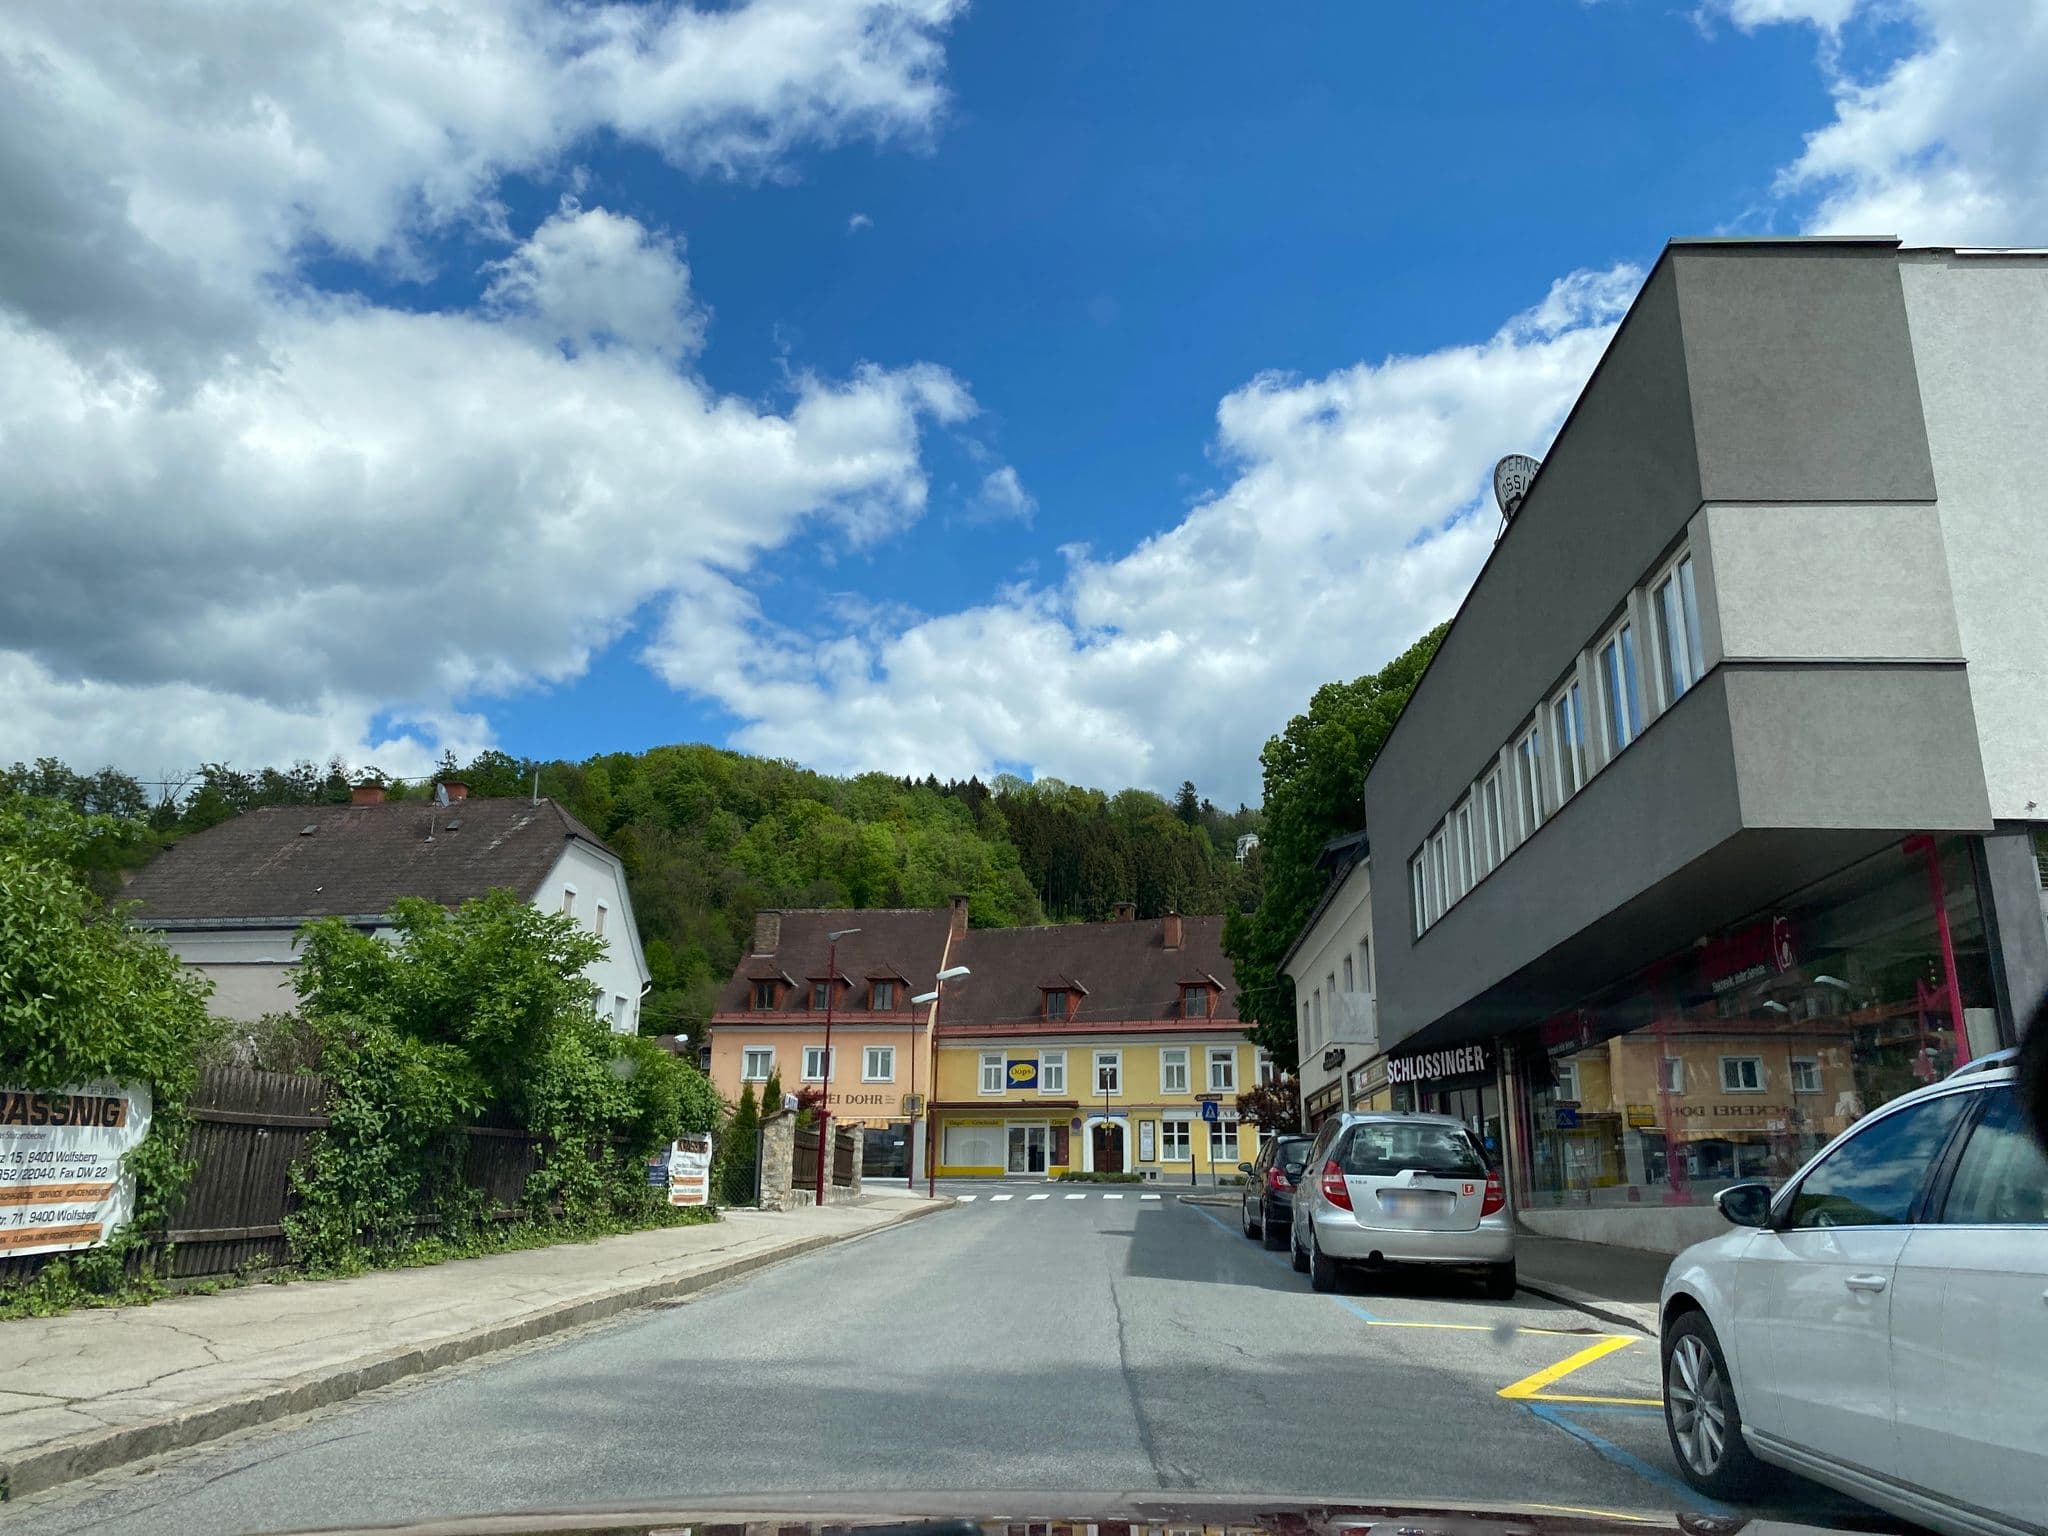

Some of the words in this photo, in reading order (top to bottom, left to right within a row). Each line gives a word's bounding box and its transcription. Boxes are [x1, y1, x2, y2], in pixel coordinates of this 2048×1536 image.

[1387, 1045, 1485, 1084] SCHLOSSINGER
[846, 1094, 883, 1105] DOHR
[28, 1151, 54, 1164] 9400
[55, 1151, 98, 1165] Wolfsberg
[60, 1168, 75, 1179] Fax
[76, 1167, 94, 1179] DW
[94, 1166, 108, 1178] 22
[29, 1210, 55, 1223] 9400
[56, 1208, 98, 1221] Wolfsberg
